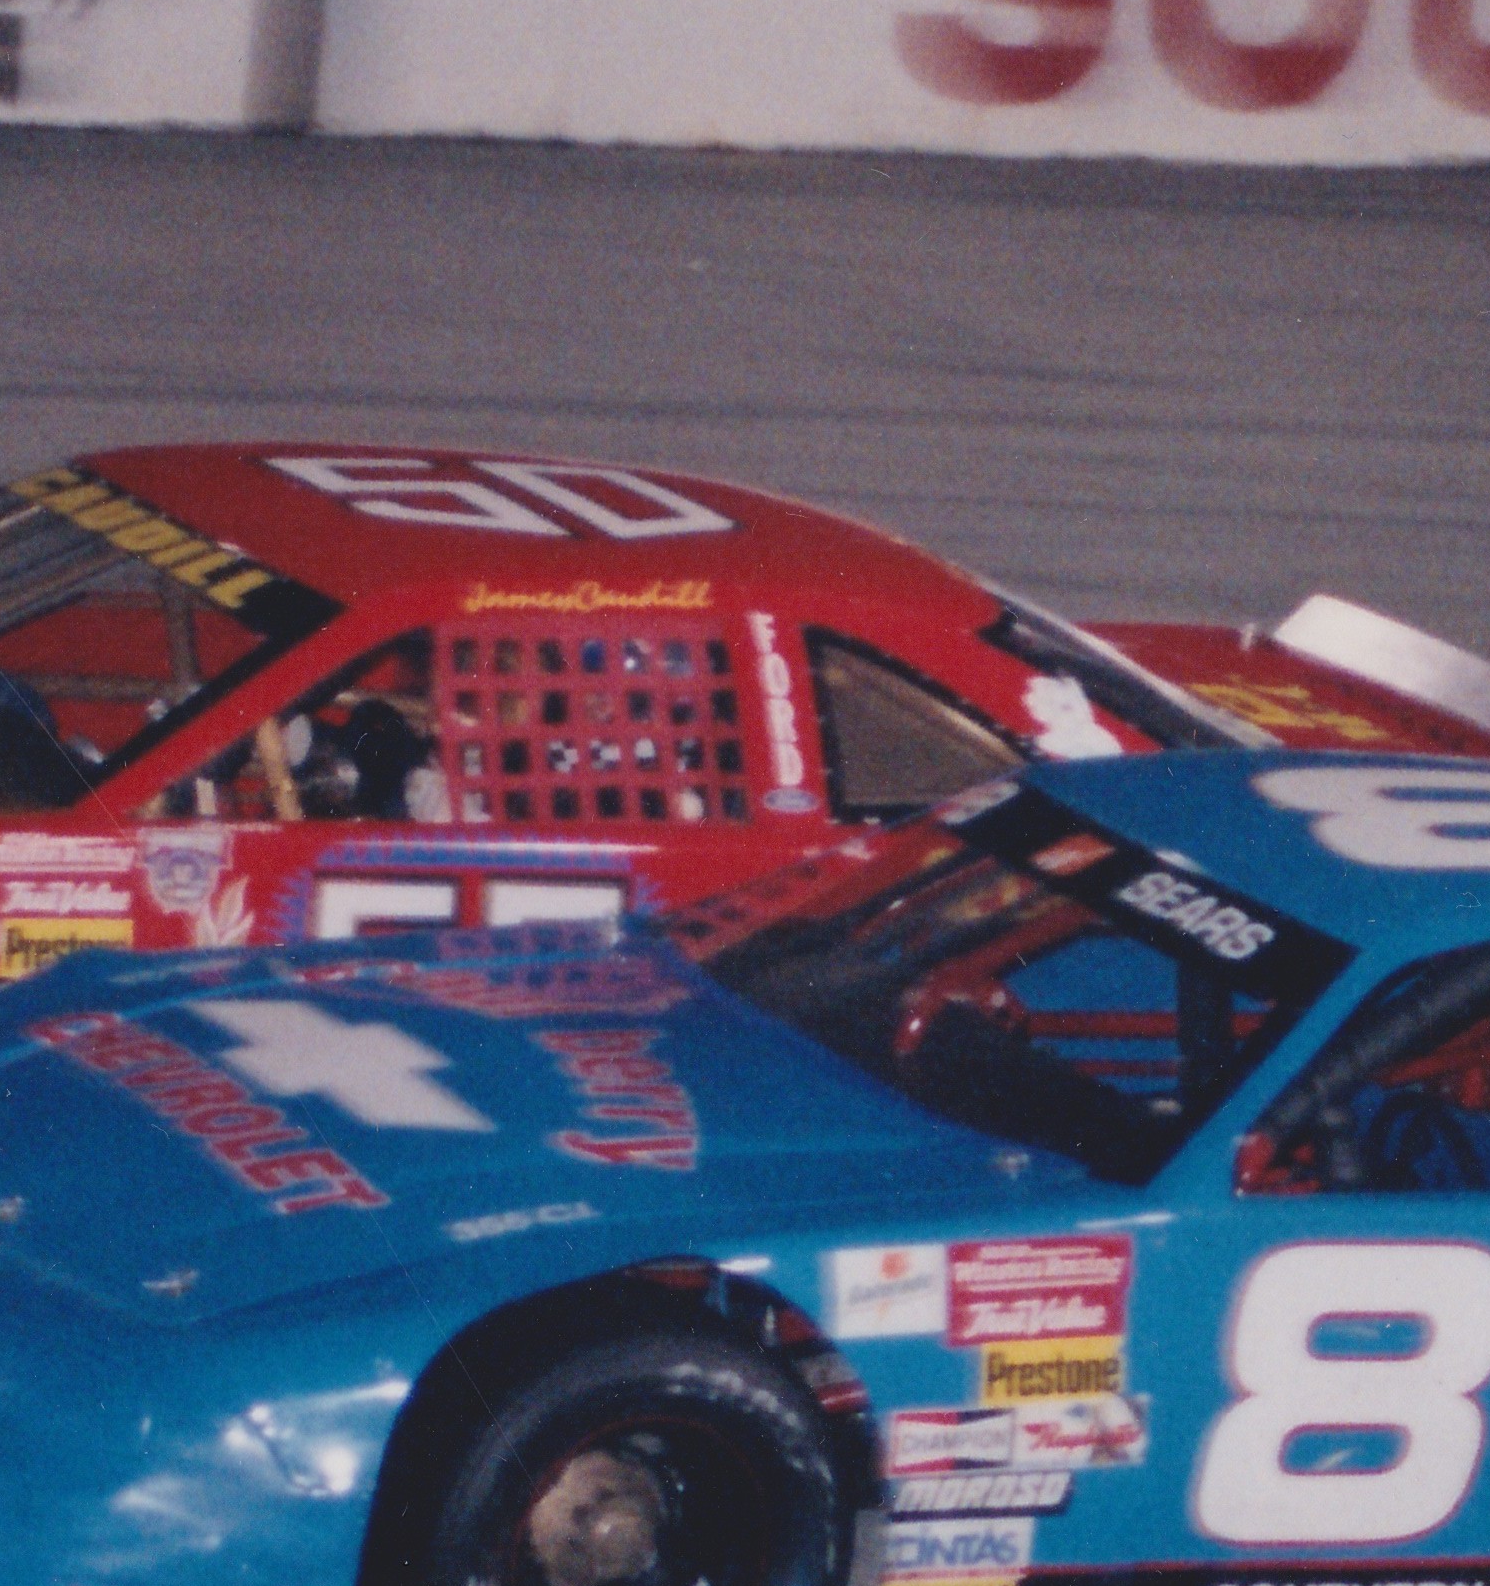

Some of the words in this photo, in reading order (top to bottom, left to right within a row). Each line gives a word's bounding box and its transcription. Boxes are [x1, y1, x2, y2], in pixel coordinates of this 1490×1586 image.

[10, 464, 276, 611] CAUDILL
[746, 609, 807, 788] FORD
[1116, 869, 1276, 963] SEARS
[21, 1010, 393, 1216] CHEVROLET
[986, 1350, 1122, 1399] Prestone
[884, 1526, 1019, 1570] CINTAS
